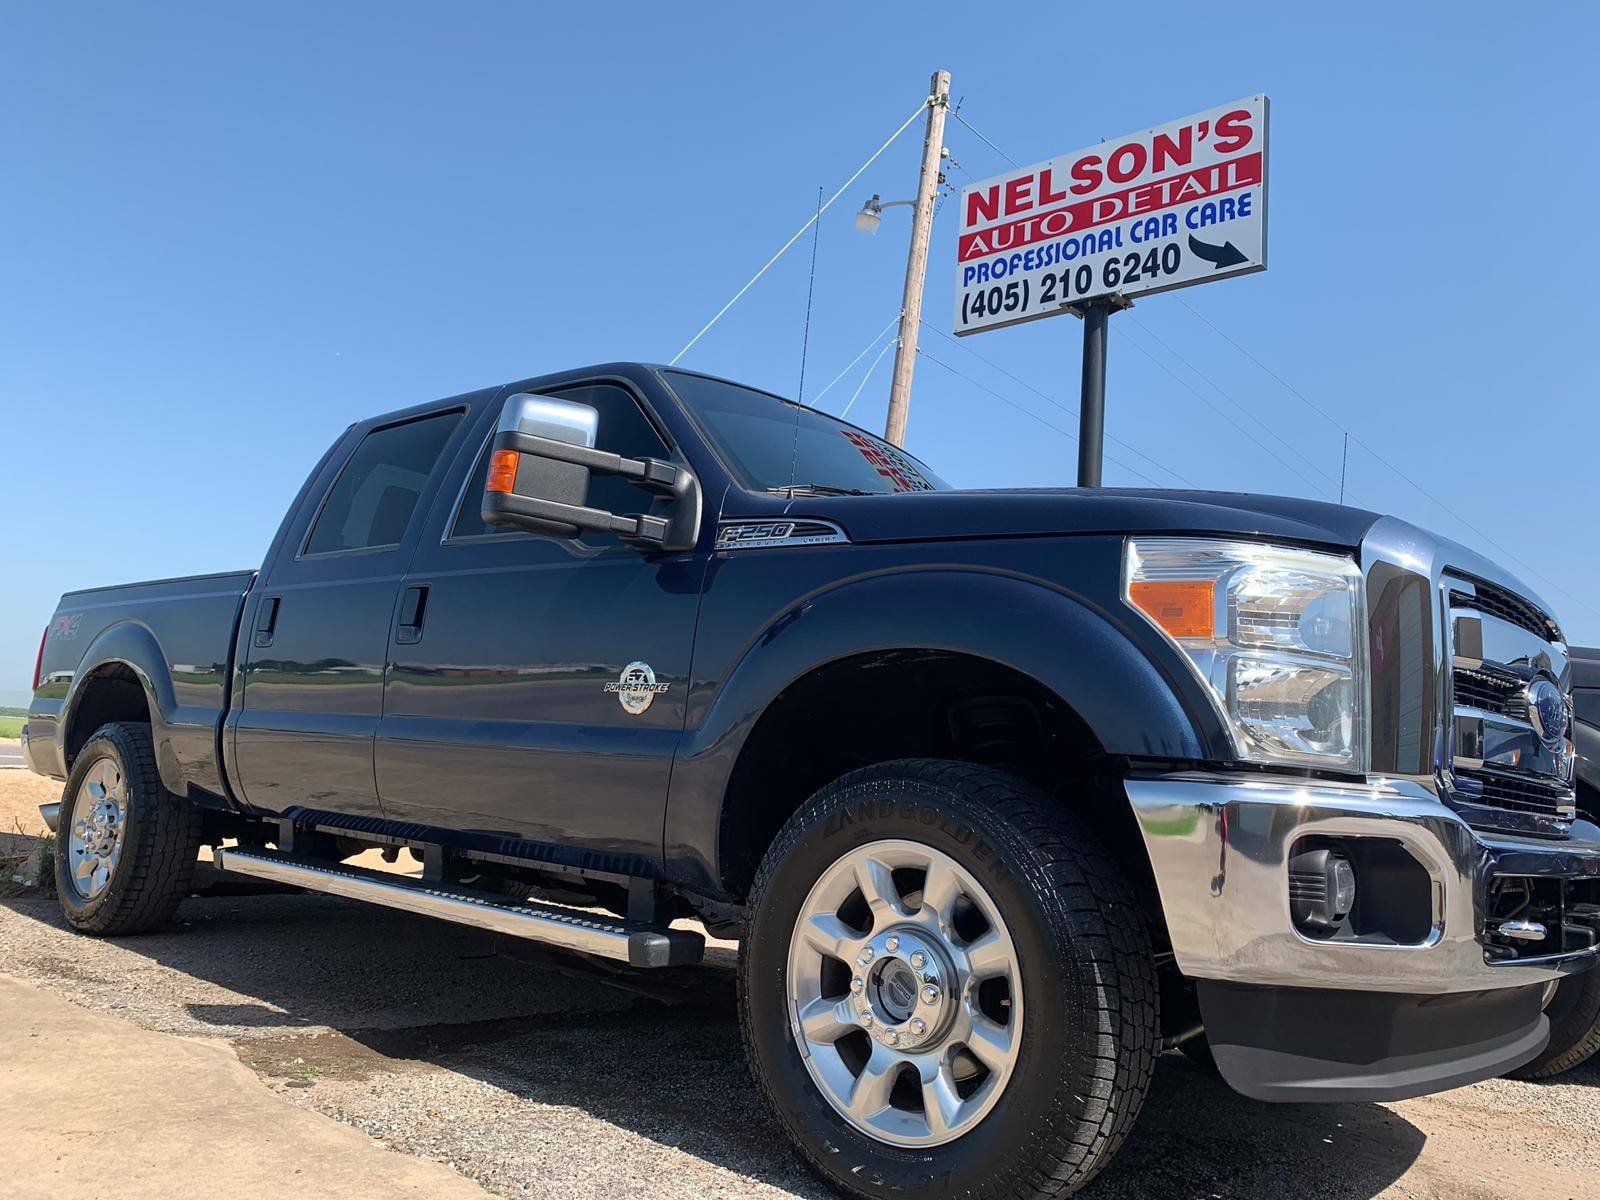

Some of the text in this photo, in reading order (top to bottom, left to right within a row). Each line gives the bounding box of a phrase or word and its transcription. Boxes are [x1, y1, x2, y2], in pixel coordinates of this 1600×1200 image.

[965, 168, 1252, 257] AUTO DETAIL
[966, 110, 1253, 227] NELSON'S
[962, 243, 1181, 324] (405) 210 6240
[963, 192, 1252, 287] PROFESSIONAL CAR CARE
